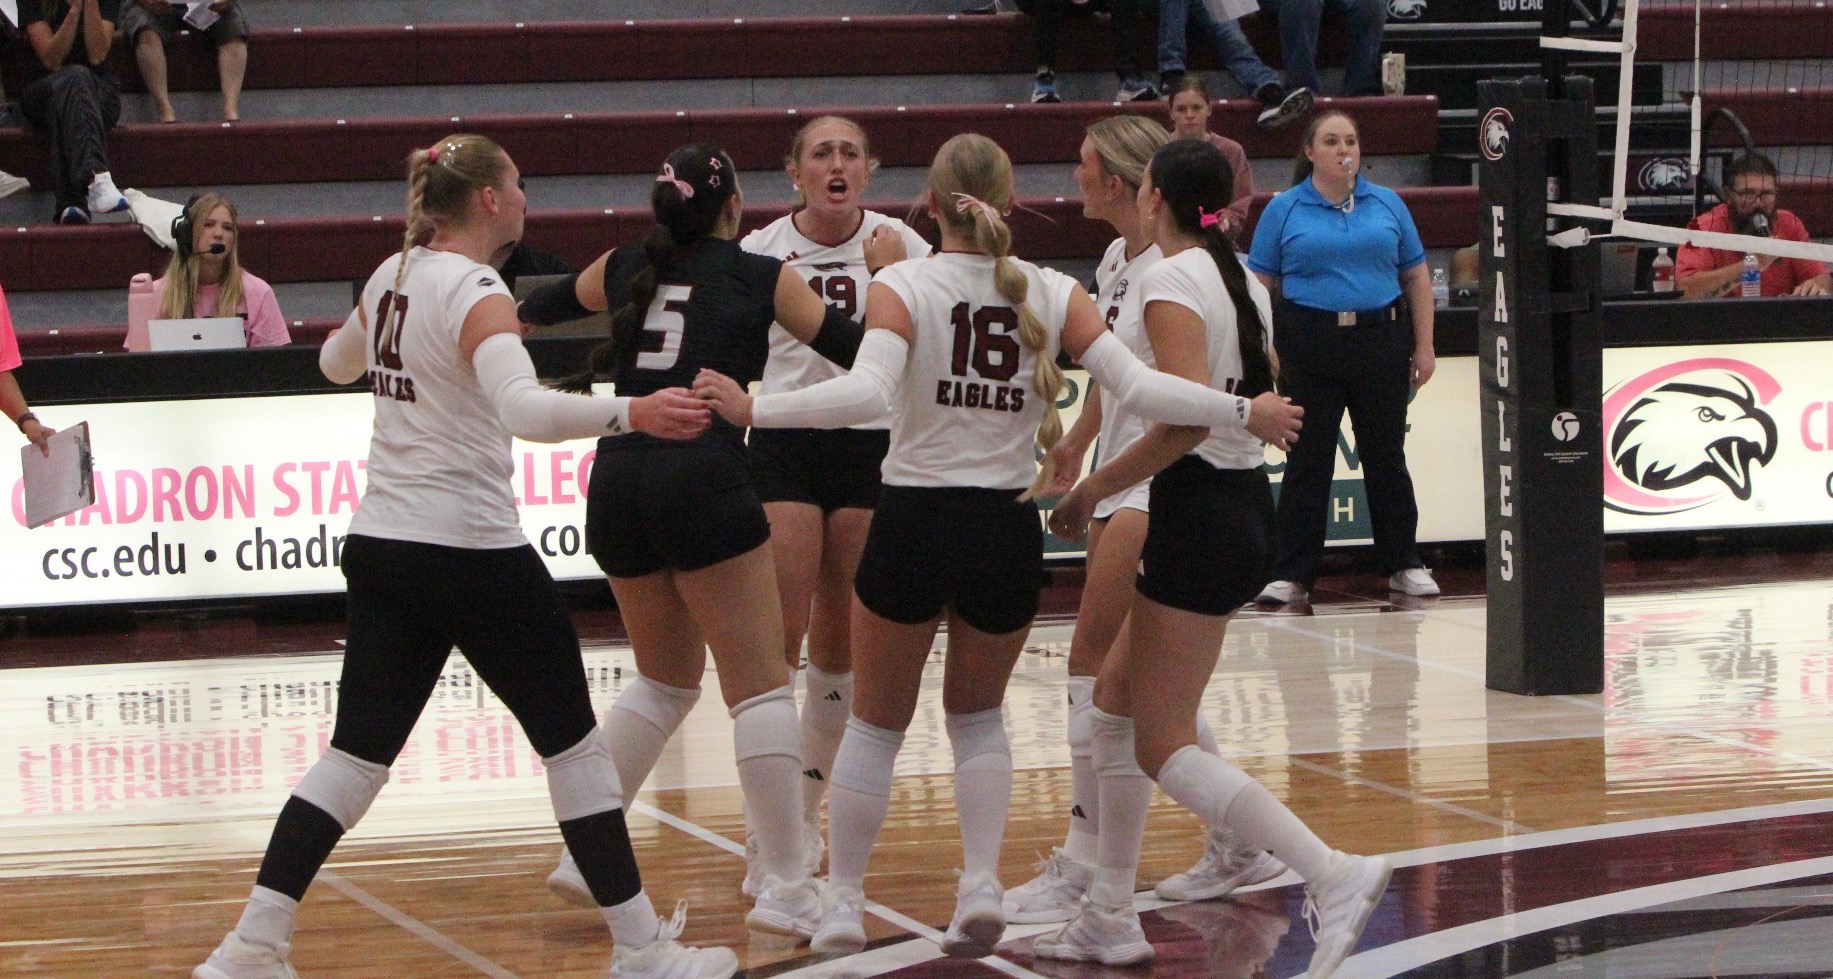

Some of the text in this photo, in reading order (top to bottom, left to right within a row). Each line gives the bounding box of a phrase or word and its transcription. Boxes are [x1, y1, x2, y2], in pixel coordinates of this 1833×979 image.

[634, 282, 695, 371] 5
[808, 275, 857, 323] 19
[951, 301, 1020, 381] 16
[936, 380, 1025, 412] EAGLES
[1492, 205, 1514, 582] EAGLES
[11, 464, 255, 528] CADRON
[42, 531, 186, 580] csc.edu
